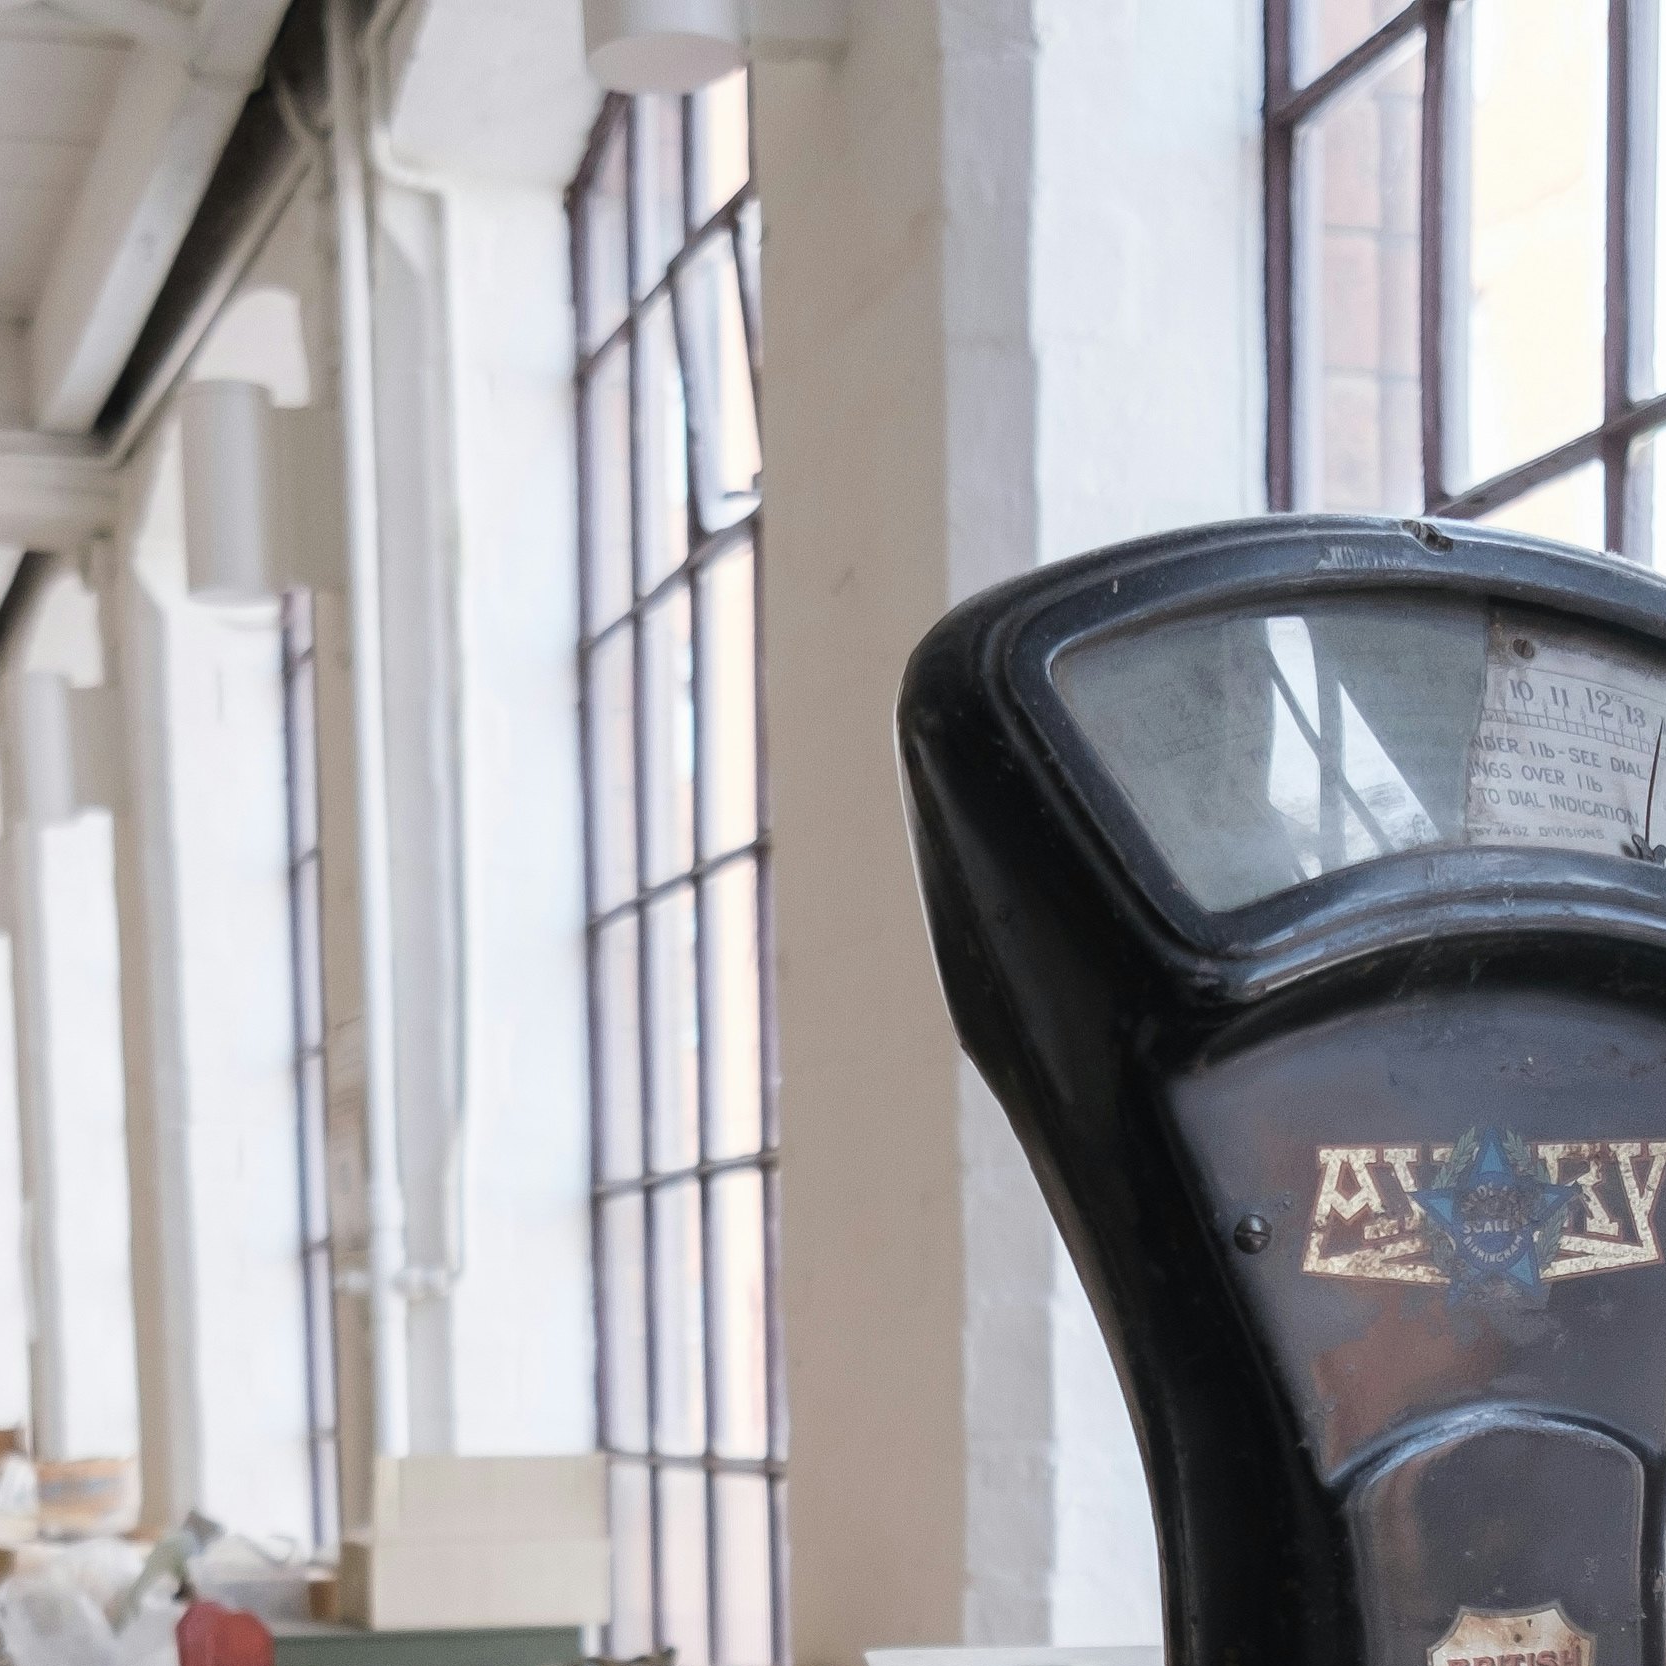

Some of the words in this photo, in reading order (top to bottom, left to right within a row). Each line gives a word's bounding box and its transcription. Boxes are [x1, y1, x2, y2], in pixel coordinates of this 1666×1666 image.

[1508, 679, 1534, 701] 10
[1550, 686, 1570, 708] 11
[1625, 704, 1646, 728] 13
[1521, 765, 1566, 786] OVER
[1610, 757, 1647, 780] DIAL
[1477, 786, 1500, 804] TO
[1508, 790, 1545, 808] DIAL
[1549, 794, 1639, 826] INDICATION
[1538, 826, 1605, 840] DIVISIONS
